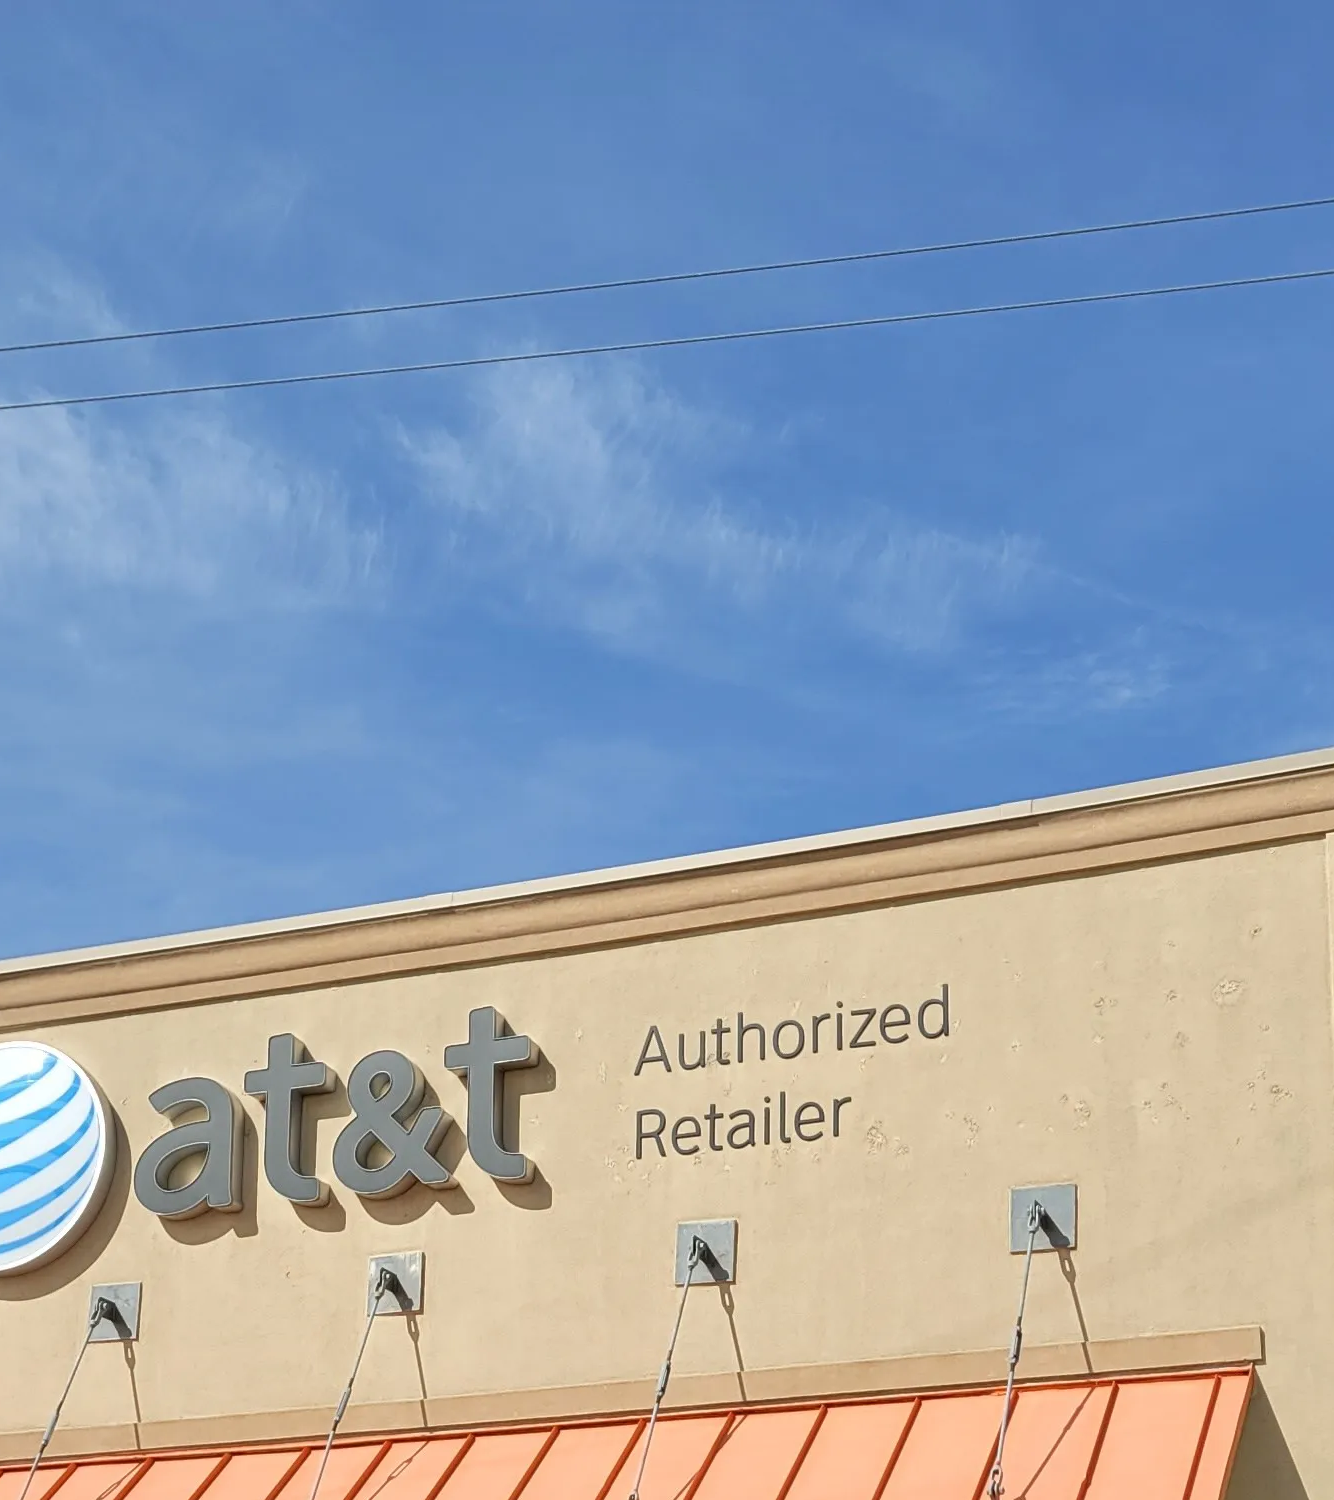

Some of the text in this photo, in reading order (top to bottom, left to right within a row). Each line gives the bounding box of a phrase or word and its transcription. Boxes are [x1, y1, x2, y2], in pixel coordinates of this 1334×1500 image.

[634, 984, 950, 1076] Authorized
[134, 1005, 537, 1218] at&t
[635, 1091, 852, 1160] Retailer
